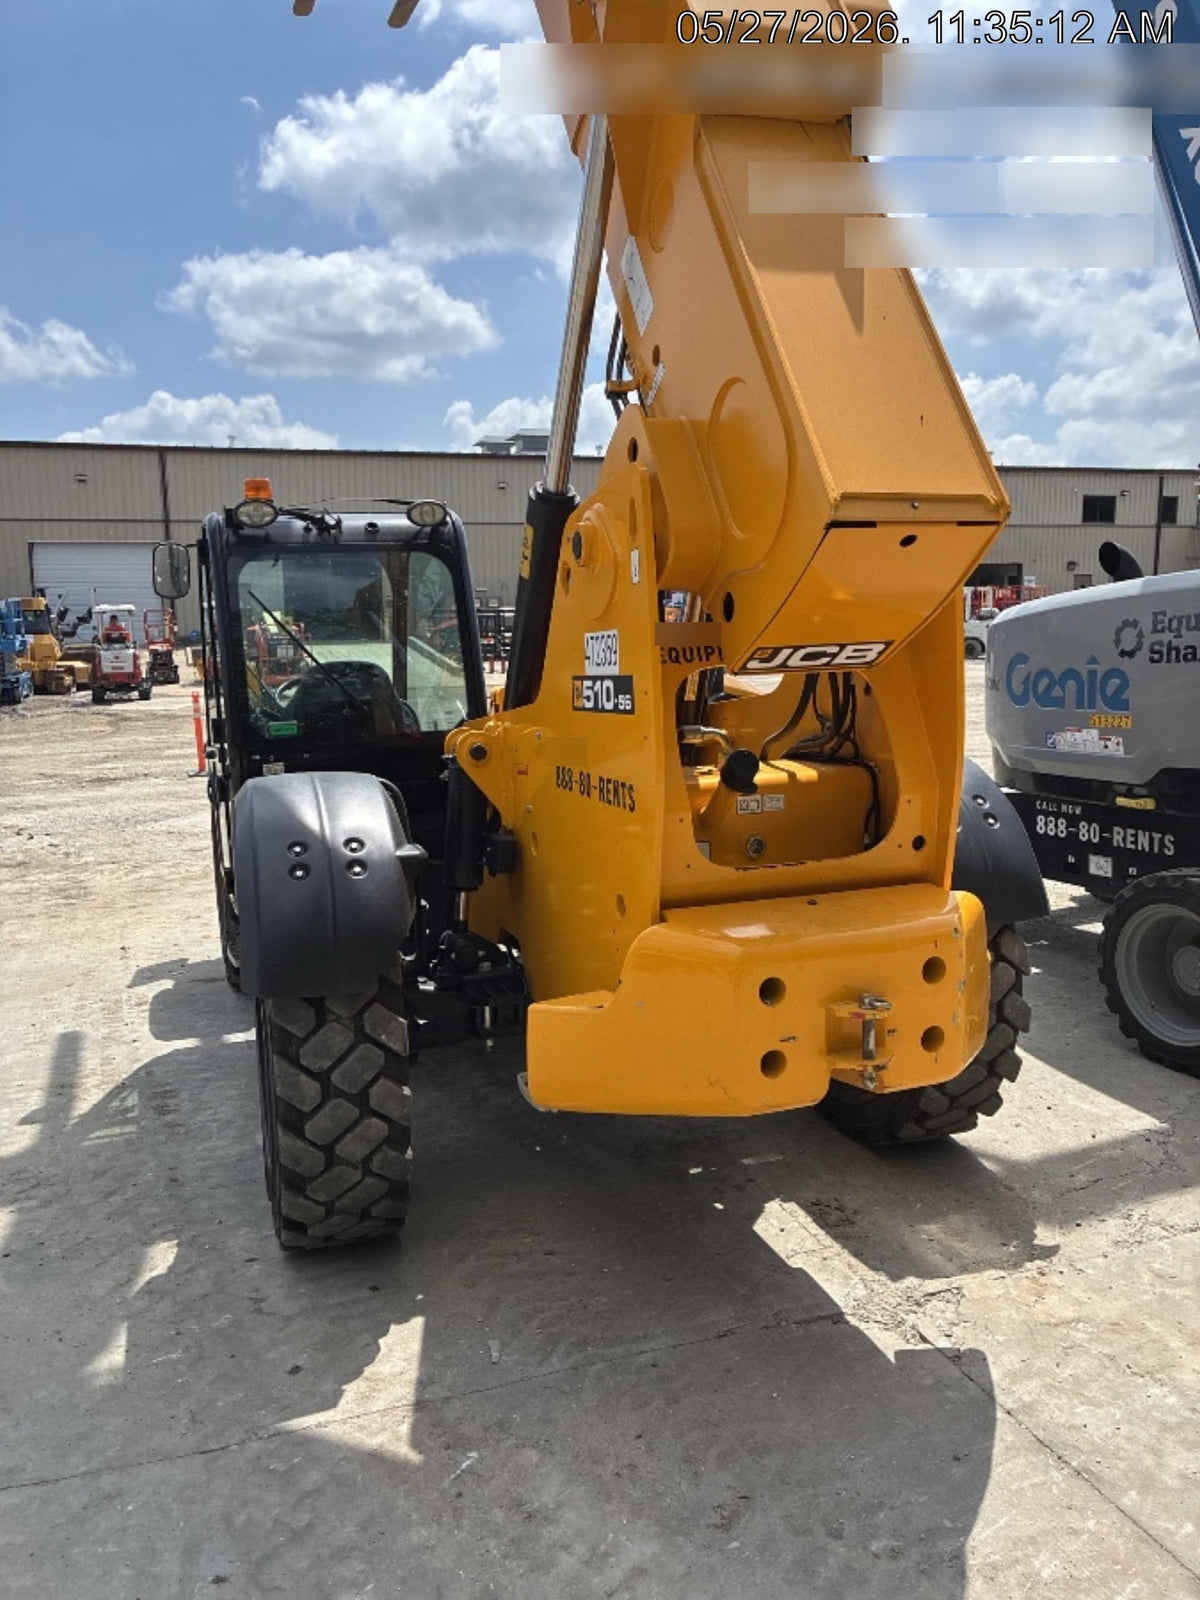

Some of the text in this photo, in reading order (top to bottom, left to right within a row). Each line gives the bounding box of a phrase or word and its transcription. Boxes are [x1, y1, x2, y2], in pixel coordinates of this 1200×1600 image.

[746, 643, 887, 669] JCB
[1148, 640, 1200, 664] Sha
[1036, 800, 1082, 815] CALL NOW
[1036, 815, 1175, 856] 888-80-RENTS
